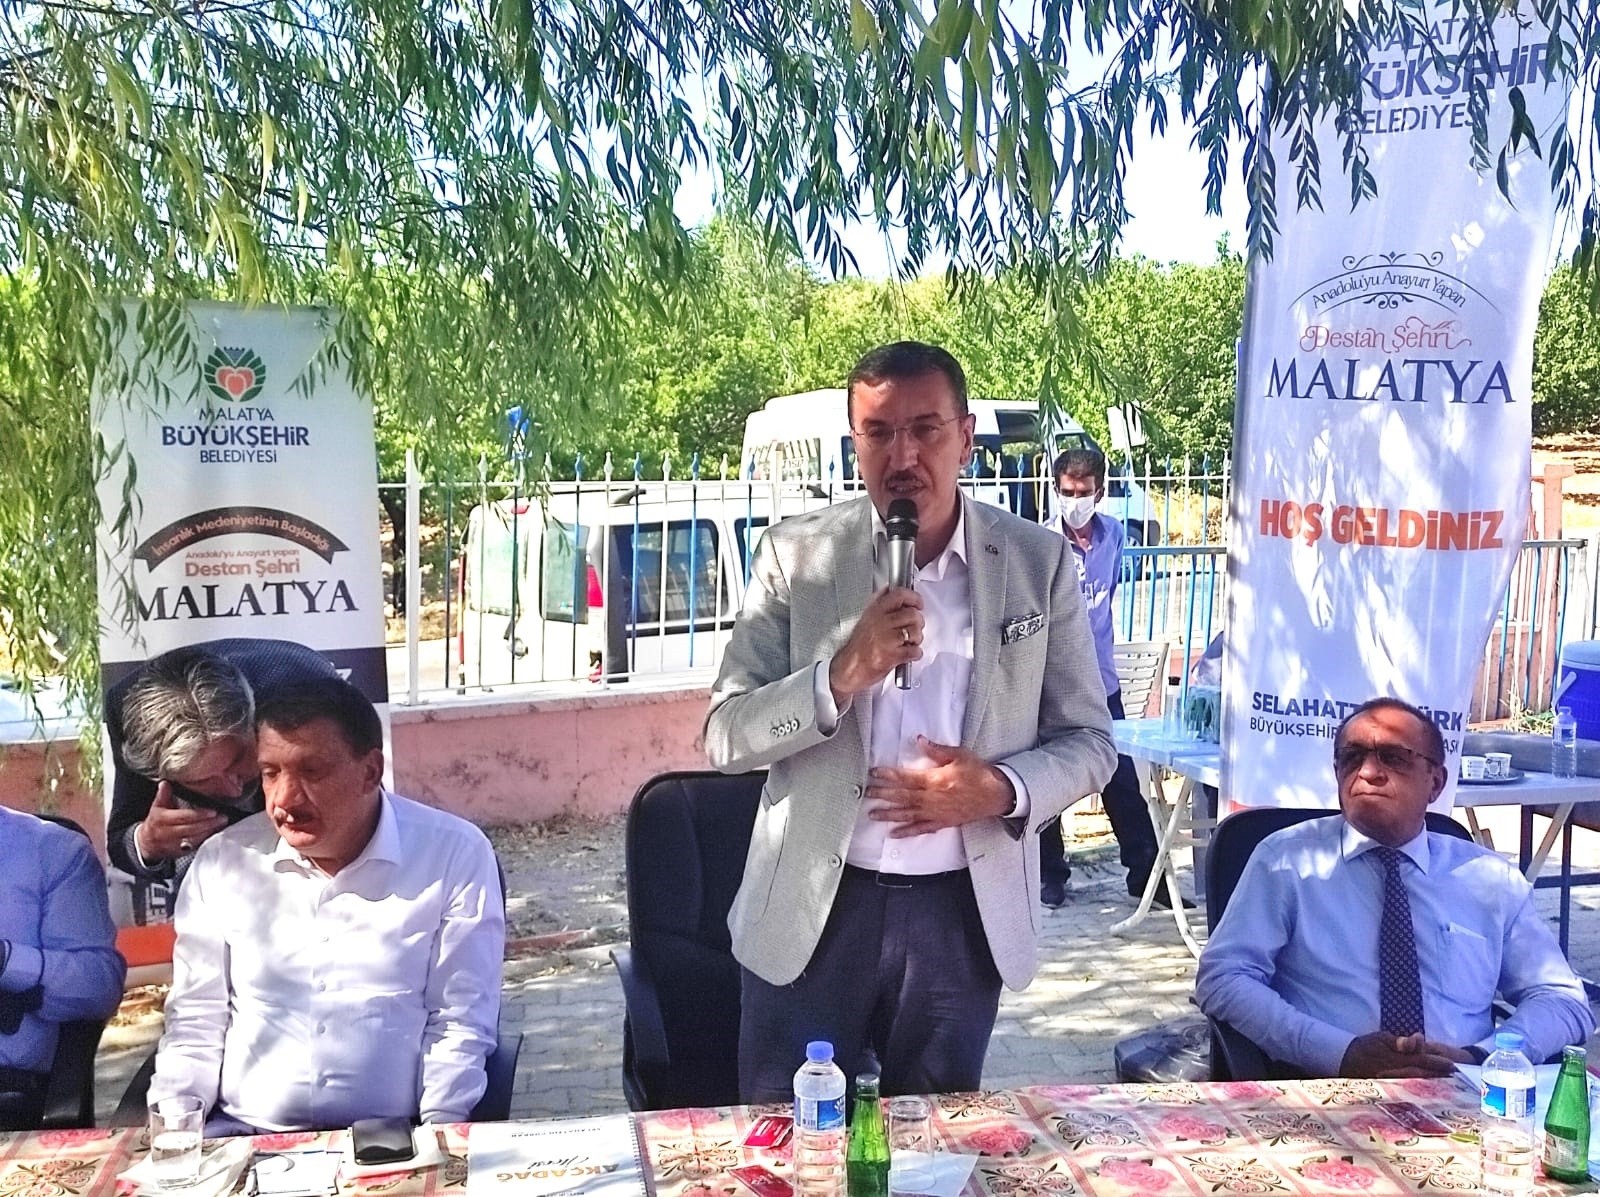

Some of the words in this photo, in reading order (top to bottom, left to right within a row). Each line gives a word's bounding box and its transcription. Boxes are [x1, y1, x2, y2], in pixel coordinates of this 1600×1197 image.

[1432, 276, 1467, 308] Yapan
[1300, 325, 1392, 353] Destan
[1392, 316, 1472, 353] Şehri
[1263, 357, 1517, 405] MALATYA
[199, 407, 275, 421] MALATYA
[195, 514, 280, 535] Medeniyetinin
[1260, 499, 1324, 547] HOŞ
[185, 561, 251, 577] Destan
[255, 558, 300, 578] Şehri
[126, 579, 360, 622] MALATYA
